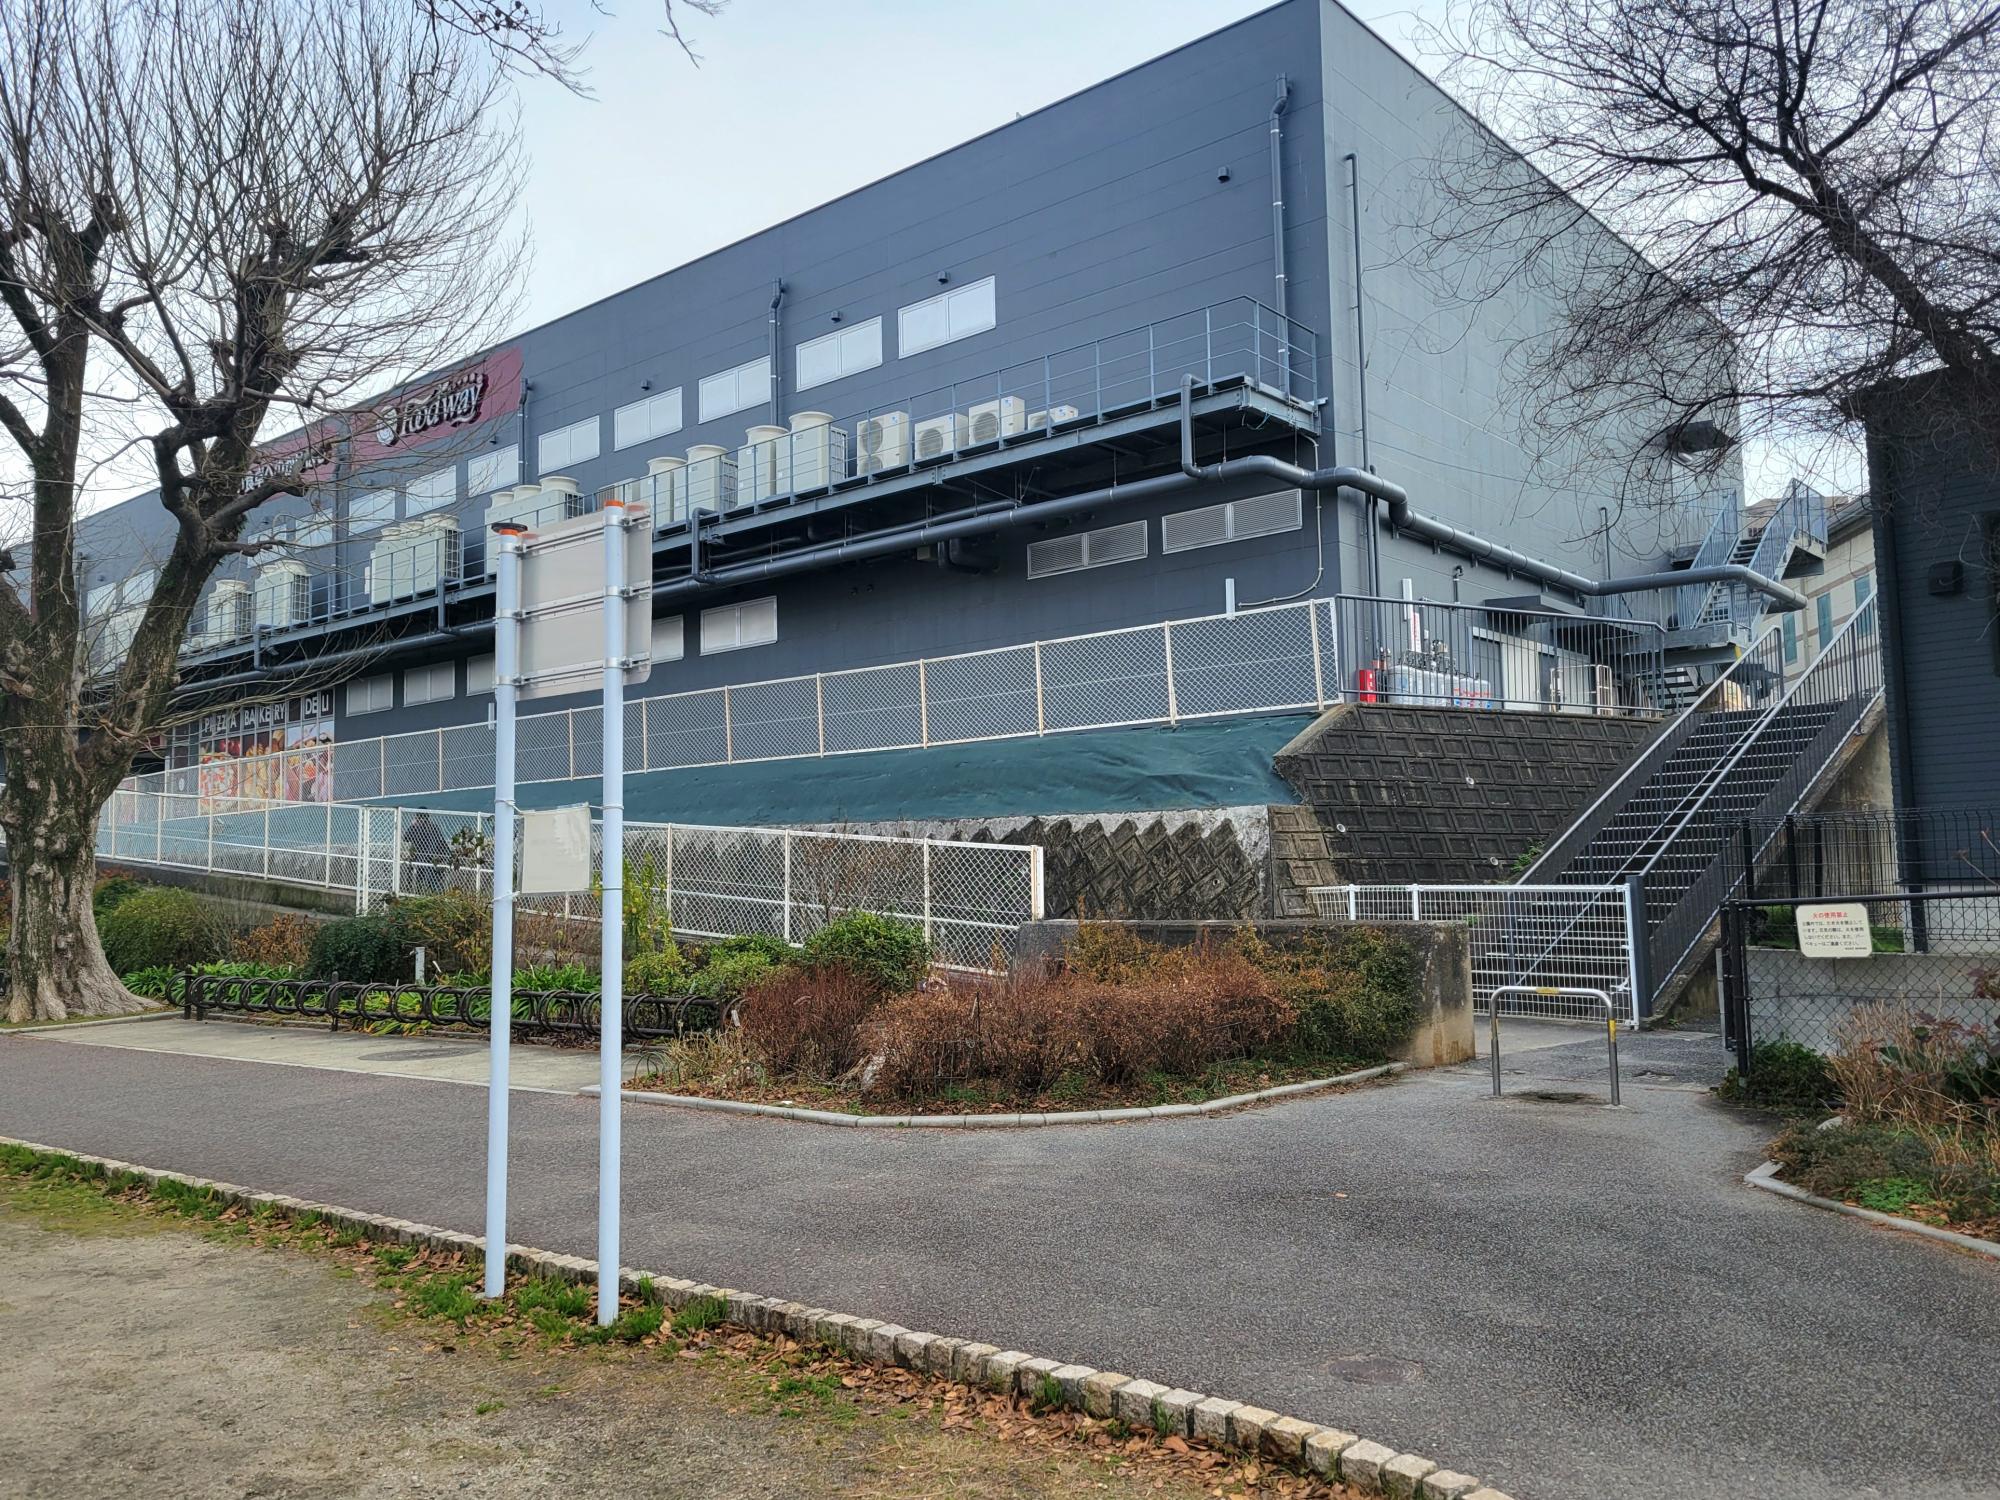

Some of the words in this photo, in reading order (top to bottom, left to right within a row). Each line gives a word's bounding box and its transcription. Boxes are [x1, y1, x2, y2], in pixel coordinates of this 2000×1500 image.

[244, 703, 286, 726] BAKERY
[305, 694, 329, 715] DELI
[1813, 911, 1848, 919] 火の使用禁止
